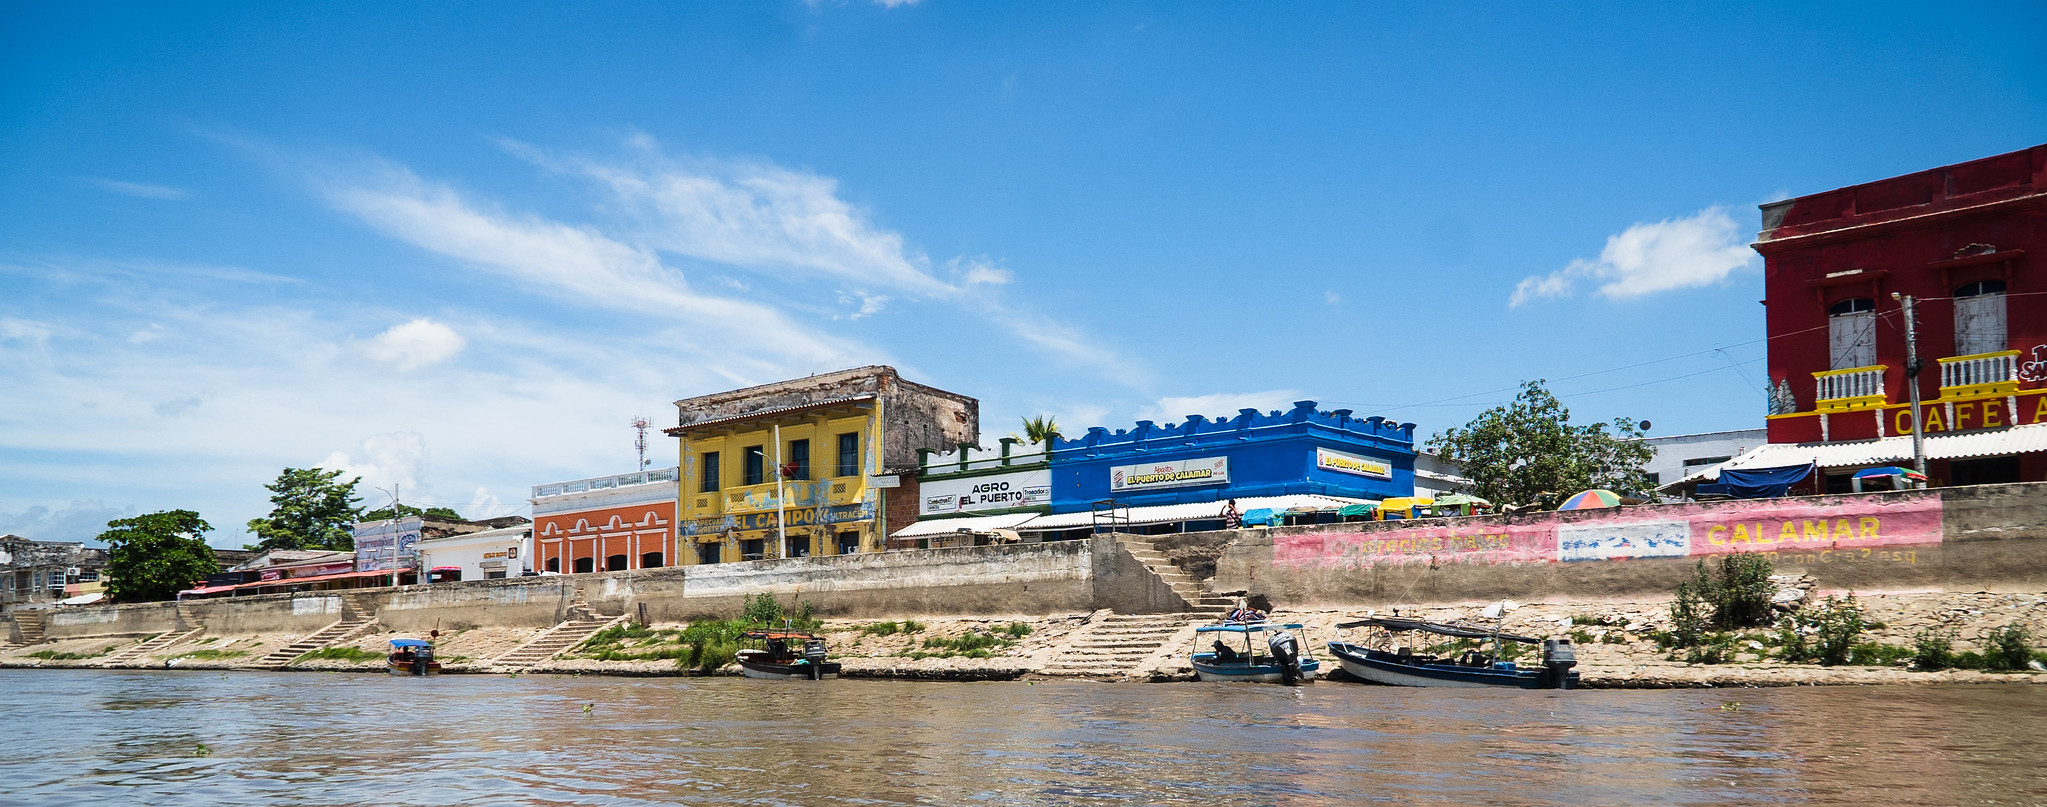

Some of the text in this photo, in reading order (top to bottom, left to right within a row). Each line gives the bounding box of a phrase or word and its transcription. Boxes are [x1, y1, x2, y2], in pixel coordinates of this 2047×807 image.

[1895, 398, 2002, 435] CAFÉ
[1127, 475, 1136, 485] EL
[1175, 468, 1212, 480] CALAMAR
[972, 482, 1009, 494] AGRO
[961, 491, 1022, 505] EL PUERTO
[736, 516, 750, 530] EL
[755, 509, 813, 528] CAMPO
[1708, 517, 1880, 546] CALAMAR
